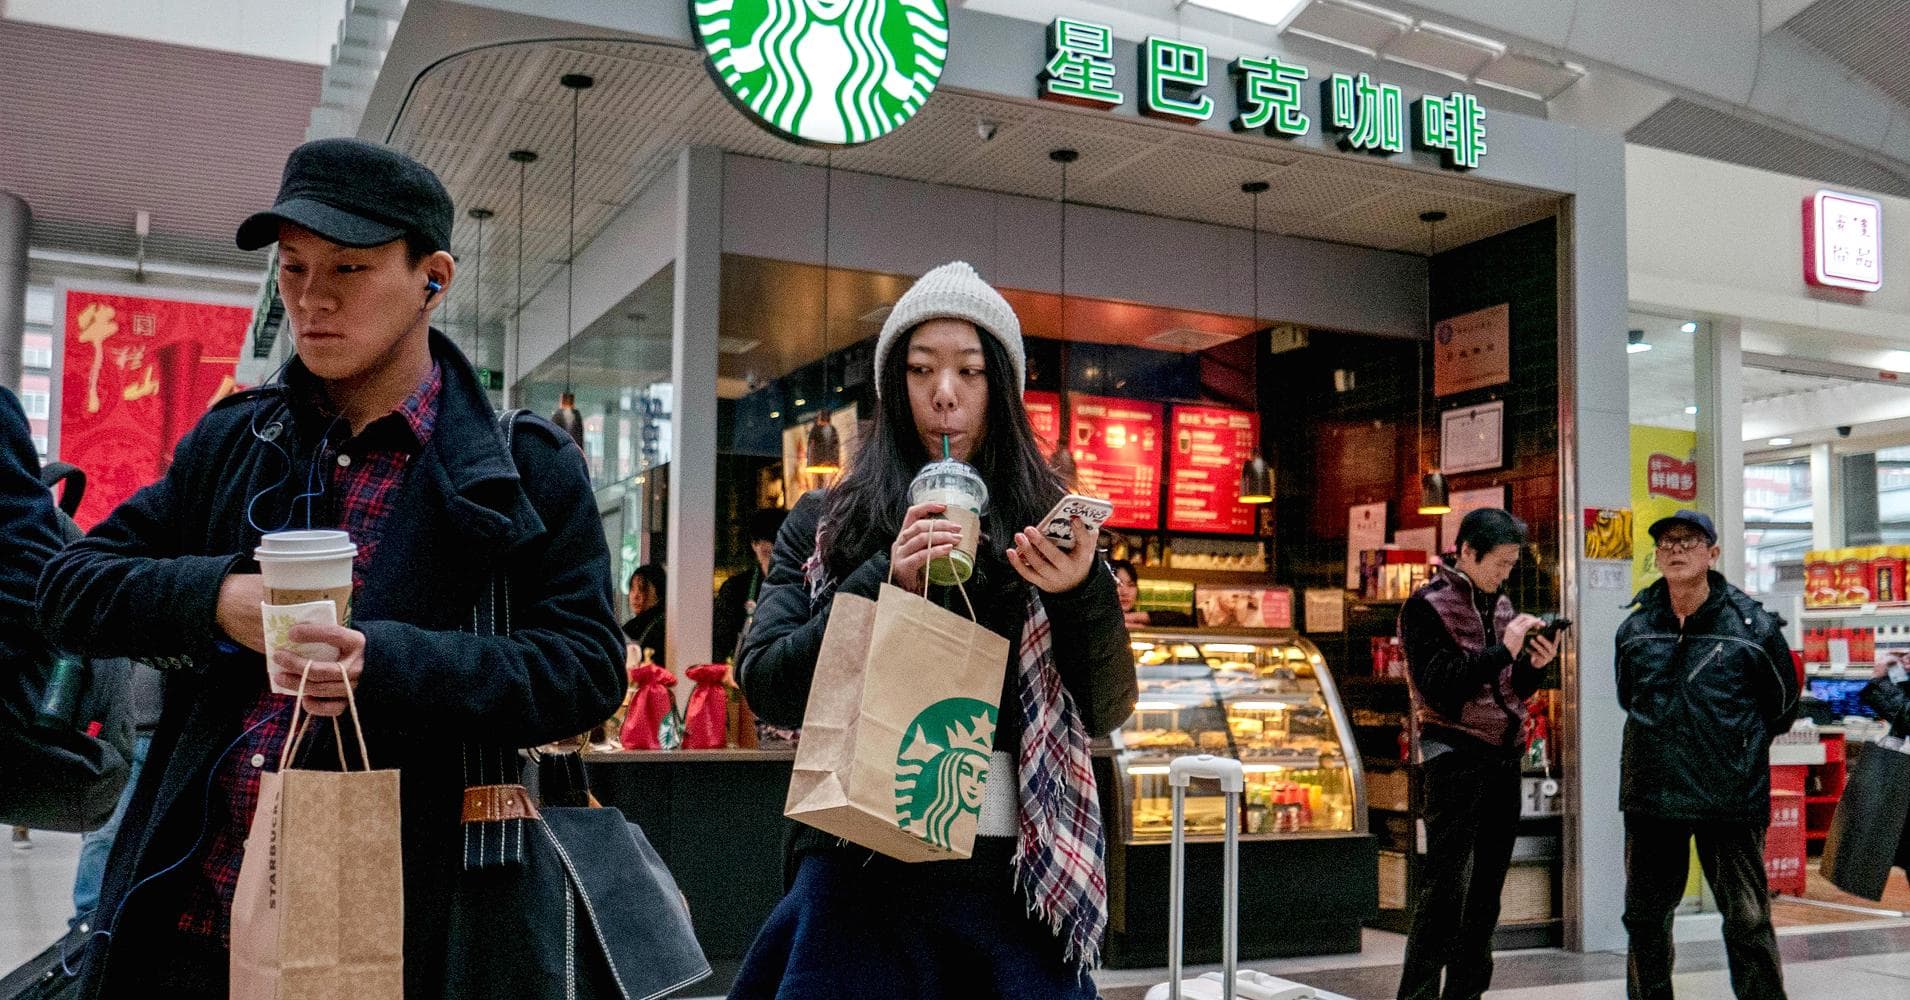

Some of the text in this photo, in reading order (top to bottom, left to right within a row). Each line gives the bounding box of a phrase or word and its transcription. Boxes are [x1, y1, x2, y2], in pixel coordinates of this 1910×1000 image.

[1044, 16, 1488, 168] 星巴克咖啡
